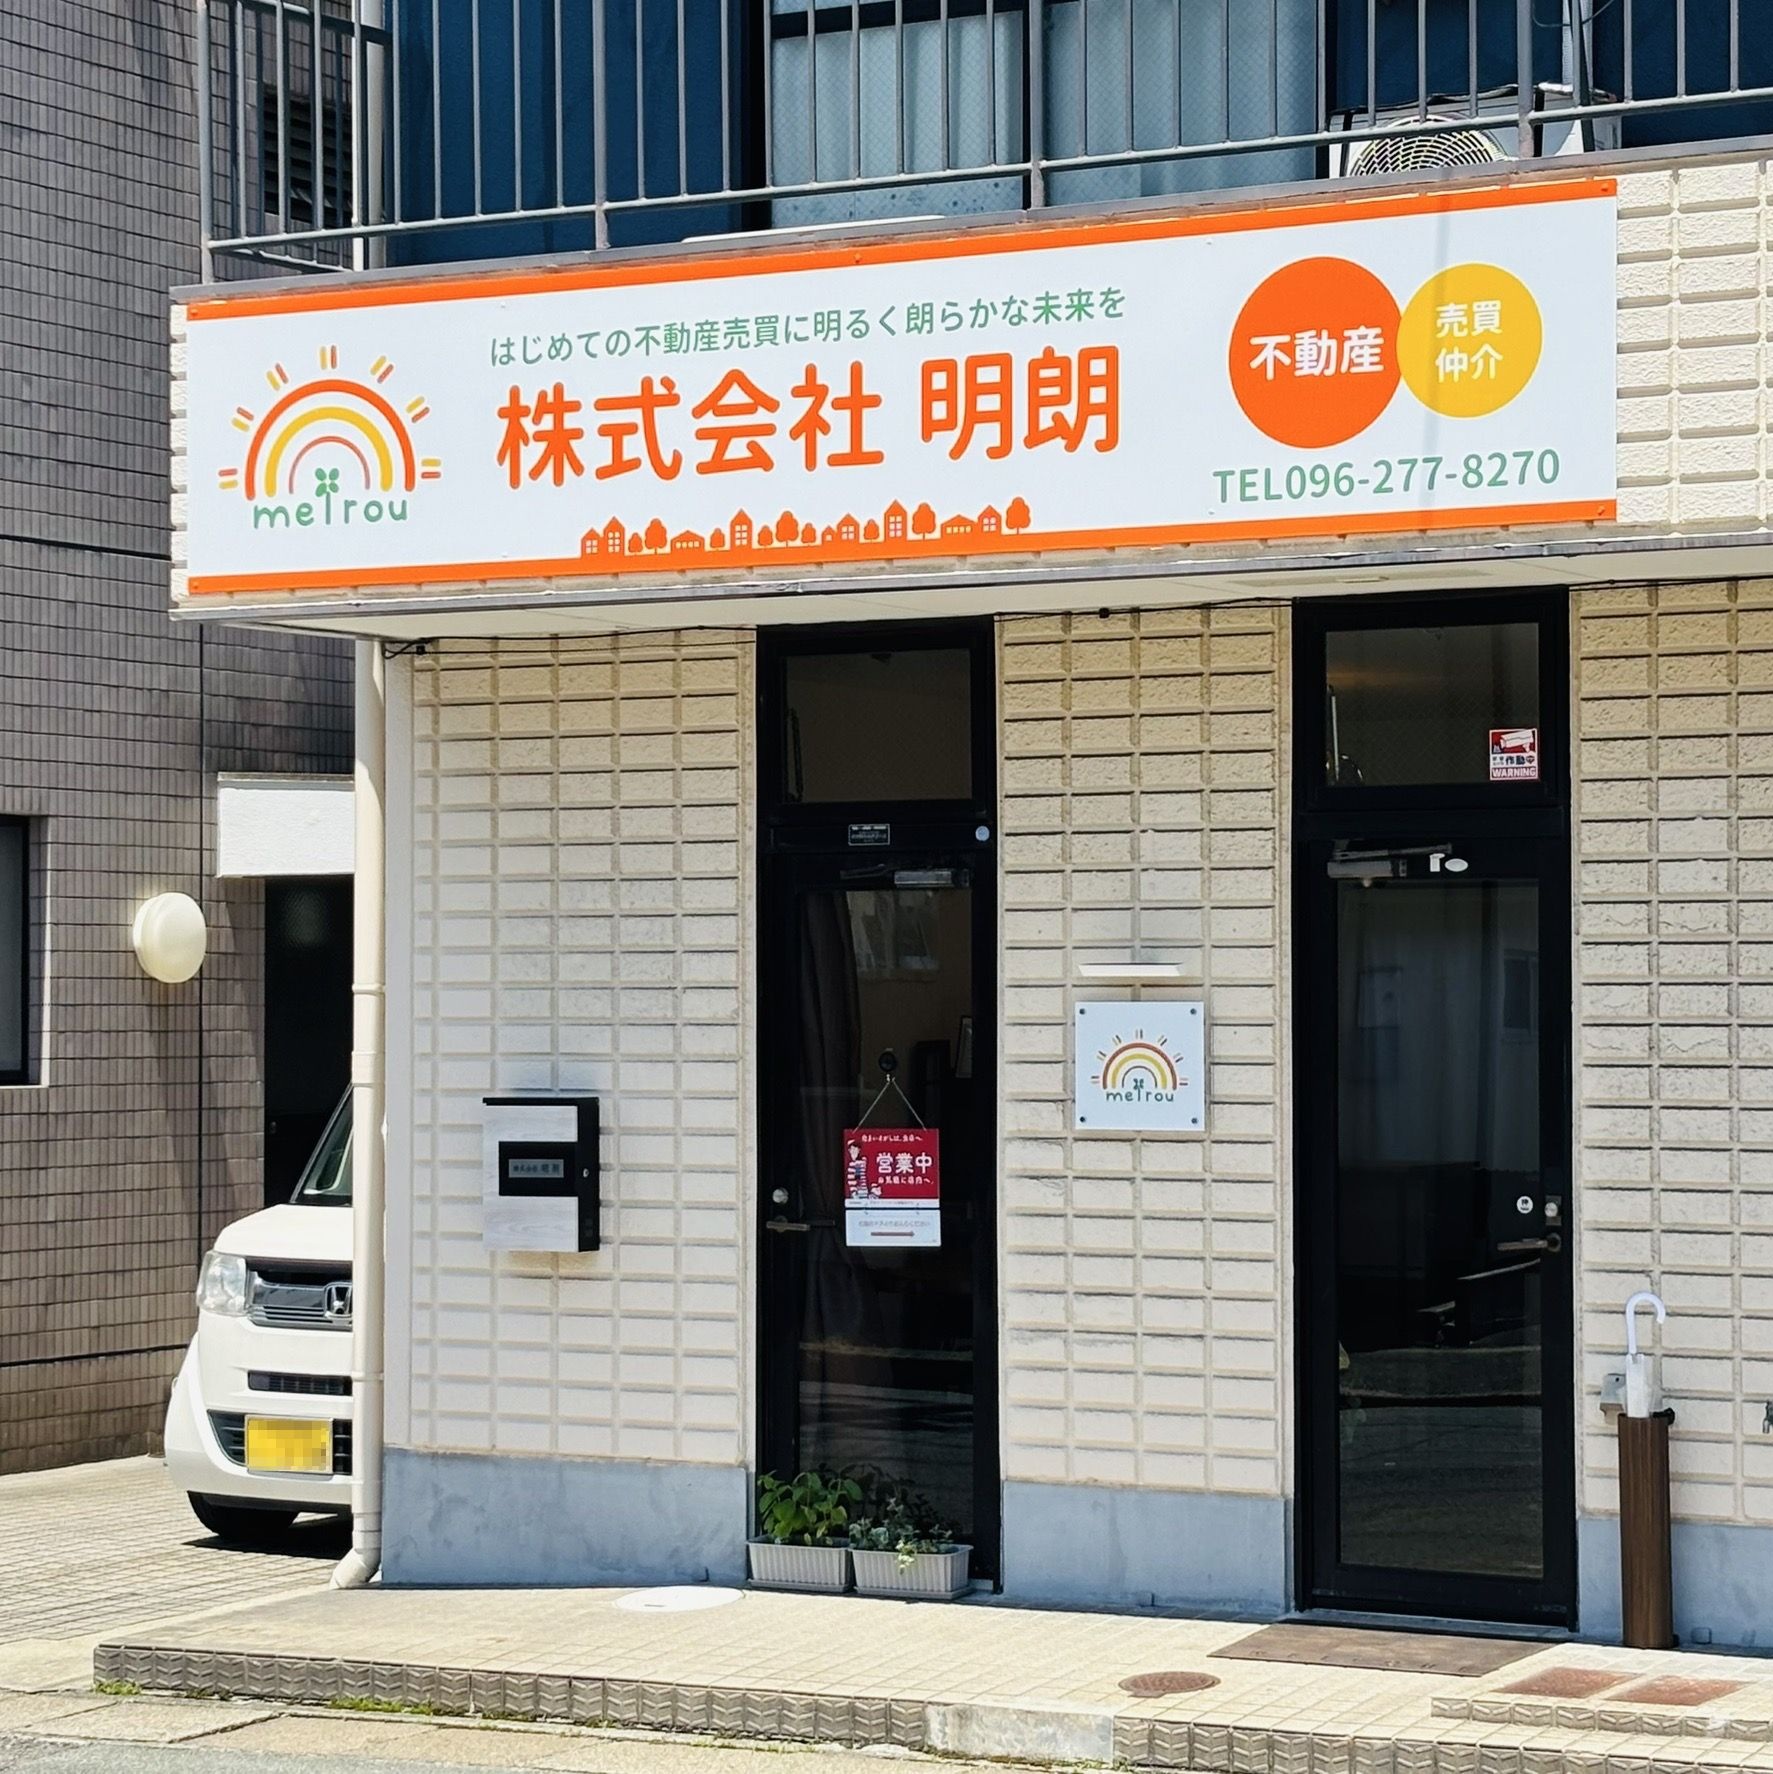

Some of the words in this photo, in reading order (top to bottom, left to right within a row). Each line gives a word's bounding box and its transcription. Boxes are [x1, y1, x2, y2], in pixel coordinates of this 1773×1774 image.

[491, 286, 1126, 367] はじめての不動産売買に明るく朗らかな未来を
[1434, 299, 1503, 339] 売買
[1248, 325, 1385, 379] 不動産
[1434, 344, 1504, 384] 仲介
[496, 361, 884, 489] 株式会社
[919, 344, 1121, 461] 明朗
[1212, 448, 1561, 506] TEL096-277-8270
[252, 489, 409, 529] meirou
[1491, 767, 1536, 778] WARNING
[1105, 1088, 1175, 1102] meirou
[876, 1151, 933, 1174] 営業中
